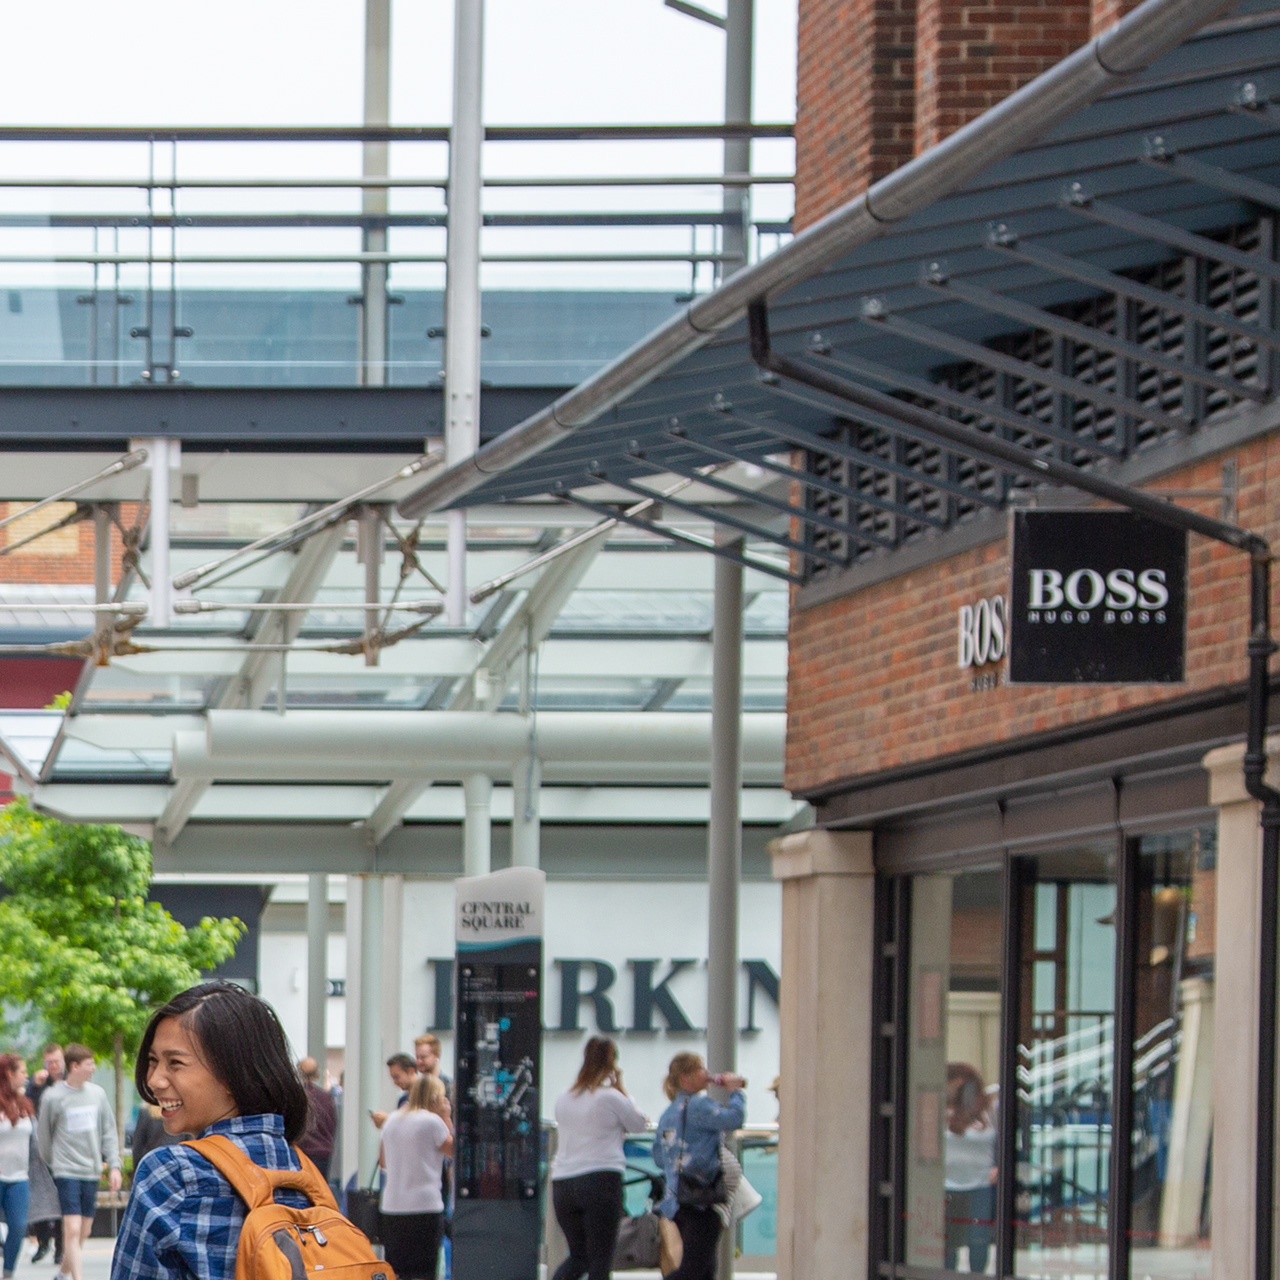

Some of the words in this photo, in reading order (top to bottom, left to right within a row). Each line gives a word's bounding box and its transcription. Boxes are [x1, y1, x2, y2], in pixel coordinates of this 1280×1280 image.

[1027, 568, 1169, 610] BOSS
[1028, 610, 1091, 624] HUGO
[1104, 611, 1167, 624] BOSS
[958, 595, 1005, 669] BOS
[461, 901, 536, 915] CENTRAL
[461, 915, 525, 931] SQUARE
